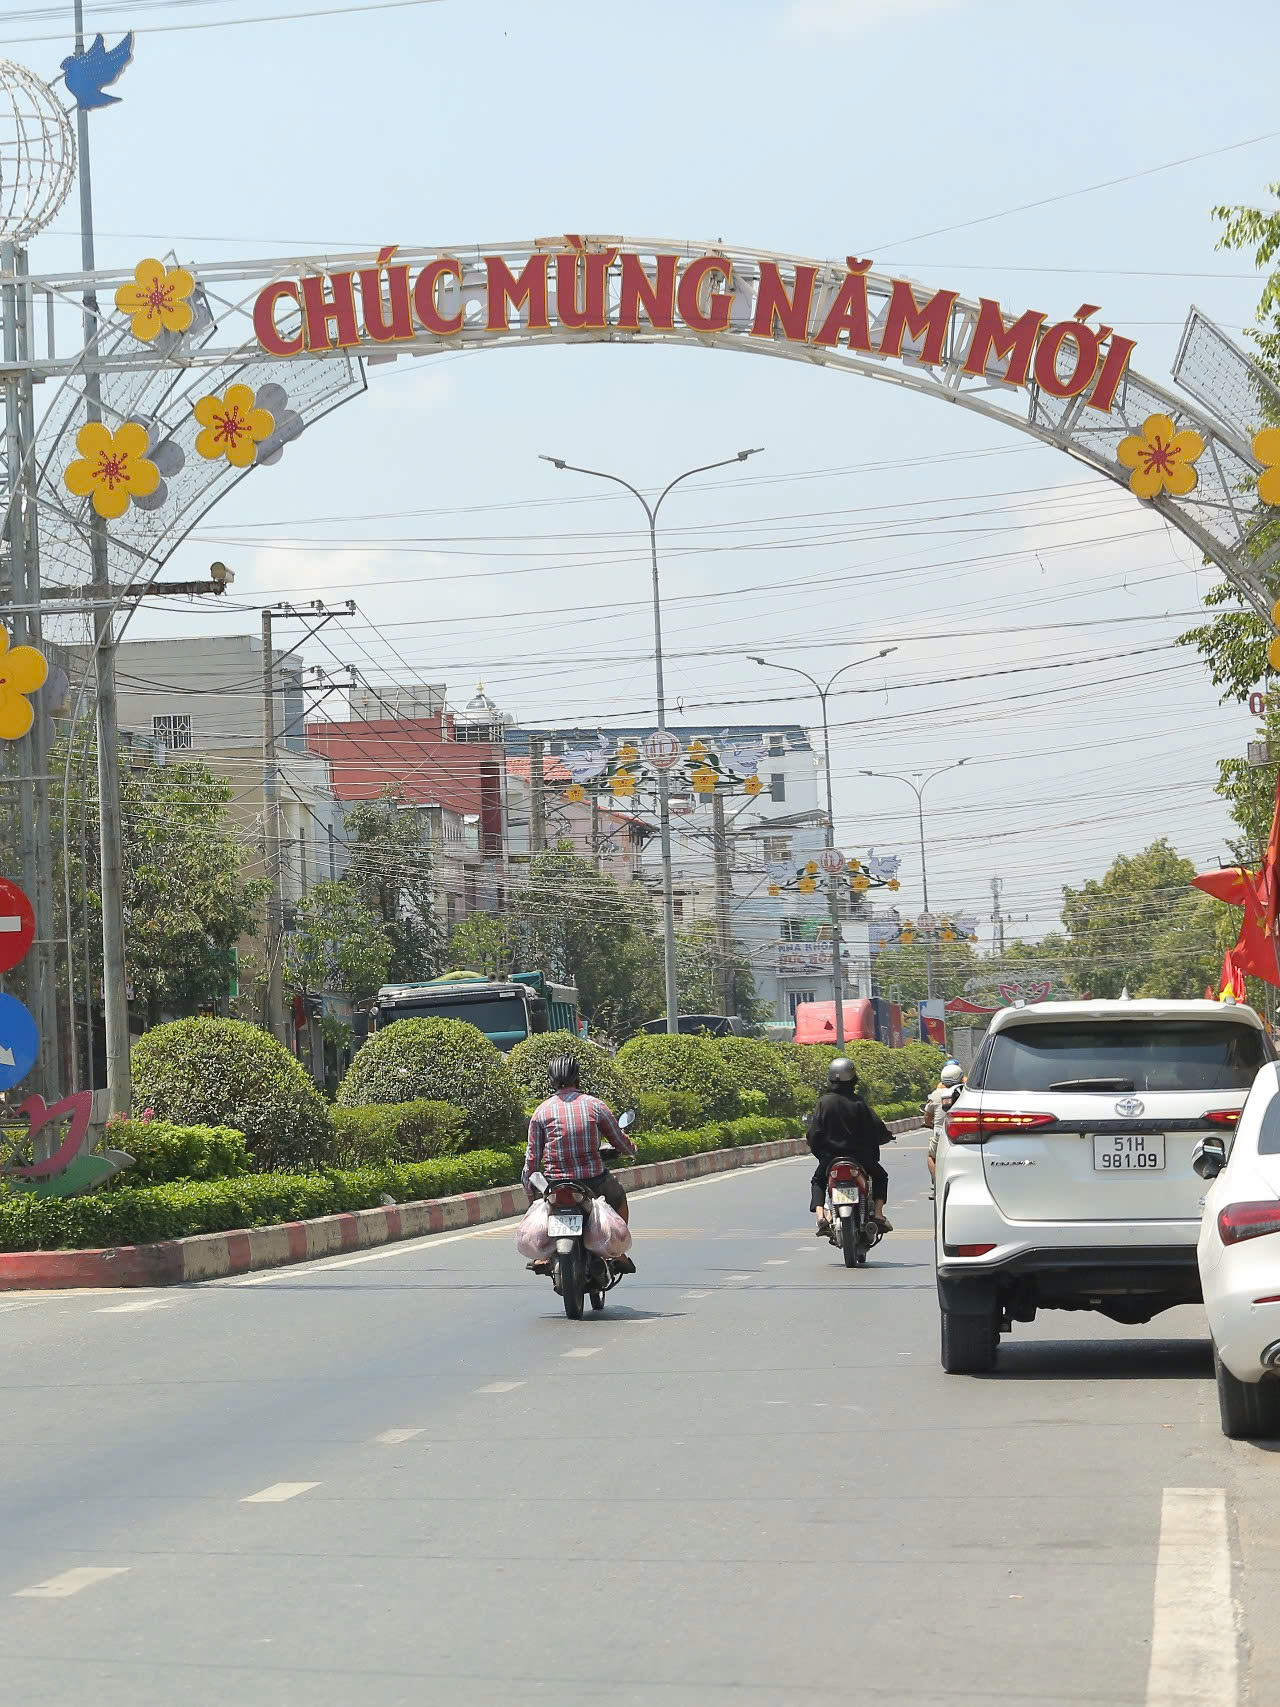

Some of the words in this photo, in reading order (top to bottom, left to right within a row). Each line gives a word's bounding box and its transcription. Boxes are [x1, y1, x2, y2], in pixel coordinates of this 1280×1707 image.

[253, 244, 465, 357] CHÚC
[484, 234, 738, 333] MỪNG
[750, 255, 960, 366] NĂM
[962, 303, 1138, 414] MỚI
[1114, 1137, 1145, 1152] 51H
[1102, 1153, 1158, 1169] 981.09
